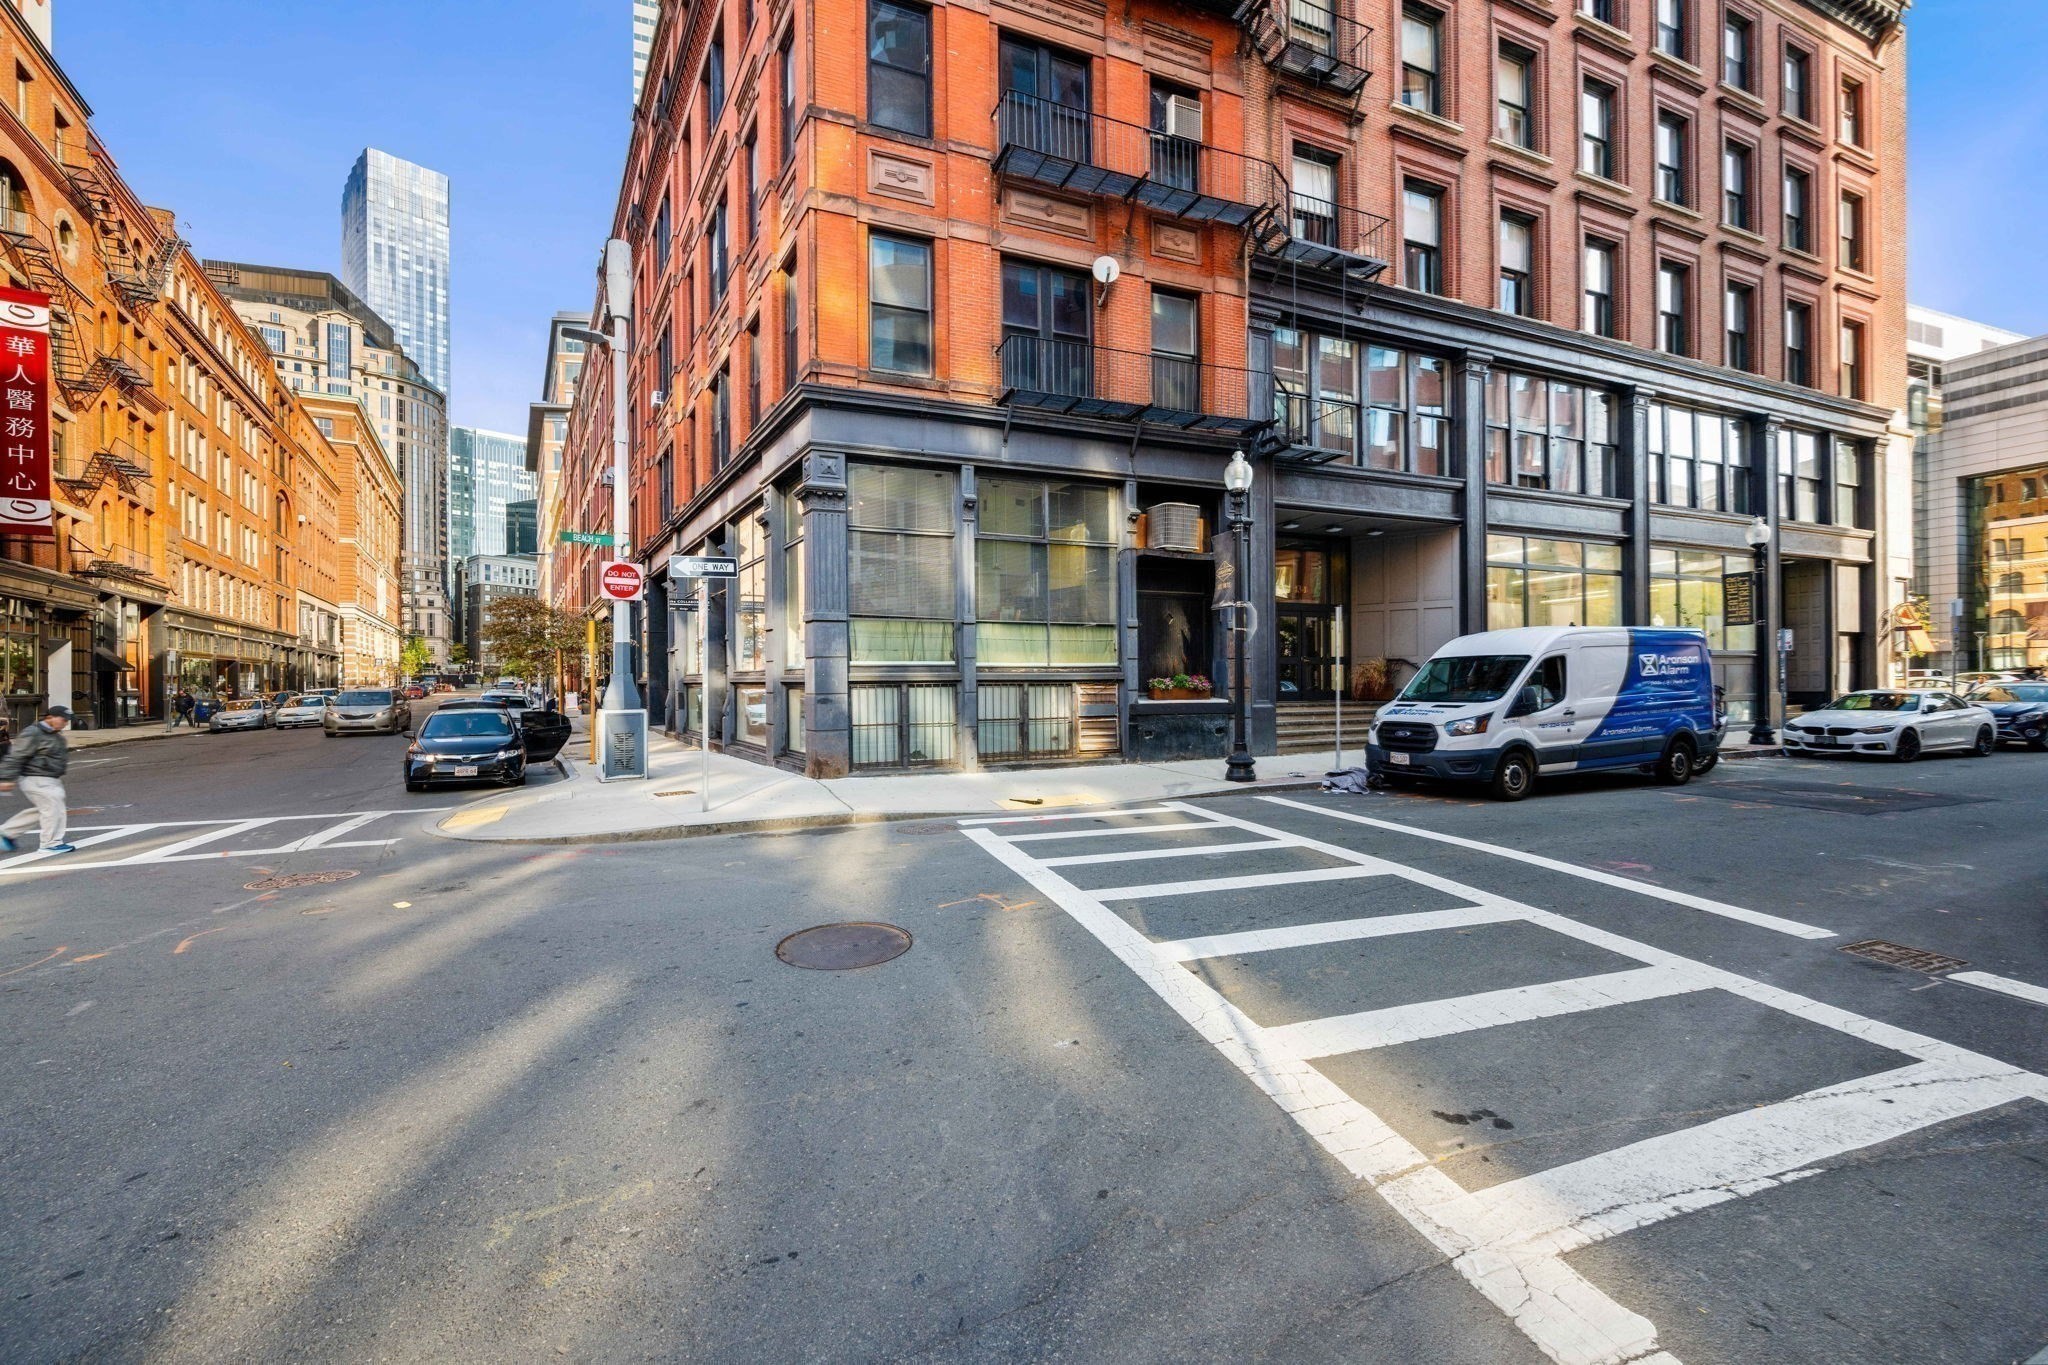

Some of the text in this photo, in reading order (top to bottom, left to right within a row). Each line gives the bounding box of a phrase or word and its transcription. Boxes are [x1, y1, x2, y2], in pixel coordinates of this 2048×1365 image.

[5, 336, 37, 491] 華人醫務中心
[573, 533, 594, 543] BEACH
[692, 562, 729, 571] ONE WAY
[609, 584, 634, 592] ENTER
[1726, 577, 1739, 617] LEATHER
[1738, 576, 1750, 616] DISTRICT
[1659, 654, 1699, 665] Aronson
[1659, 665, 1689, 675] Alarm
